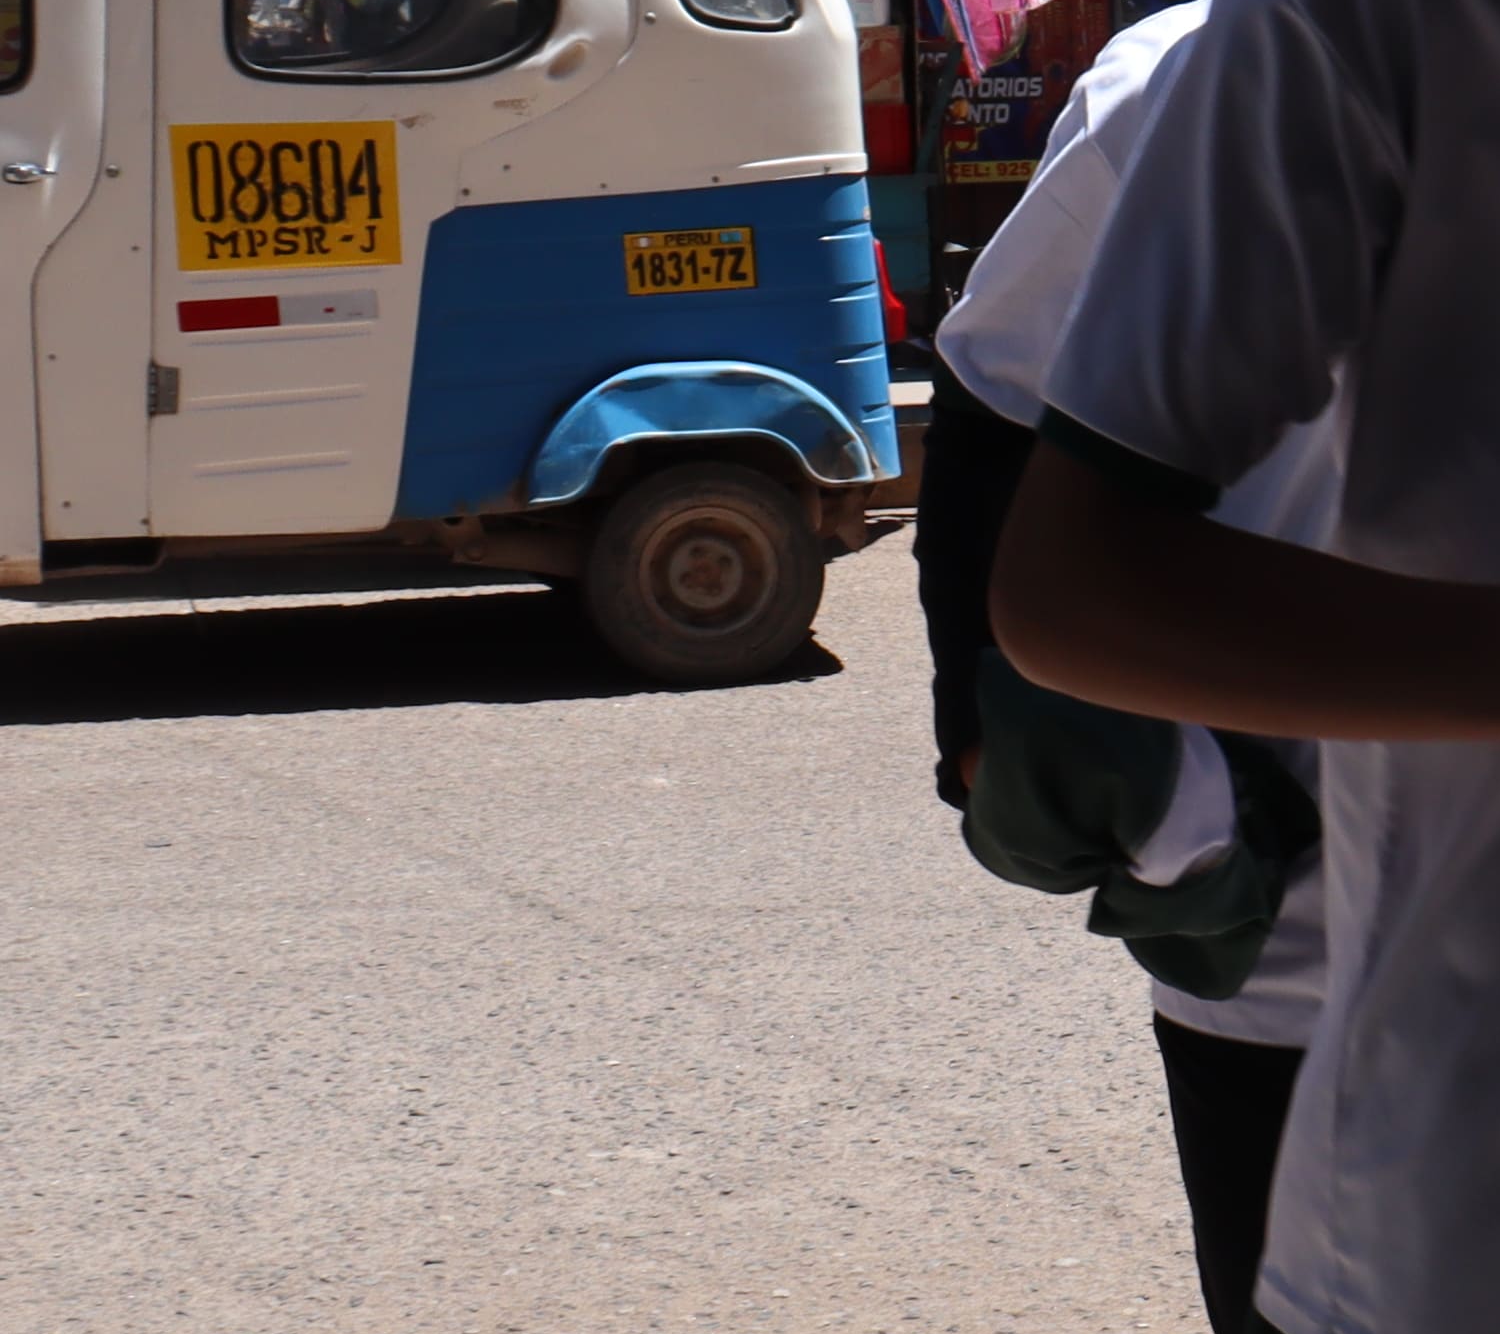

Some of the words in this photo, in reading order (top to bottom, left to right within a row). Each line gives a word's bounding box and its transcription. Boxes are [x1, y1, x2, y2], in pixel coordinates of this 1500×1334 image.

[187, 139, 383, 225] 08604
[663, 232, 713, 247] PERU
[631, 247, 748, 289] 1831-7Z
